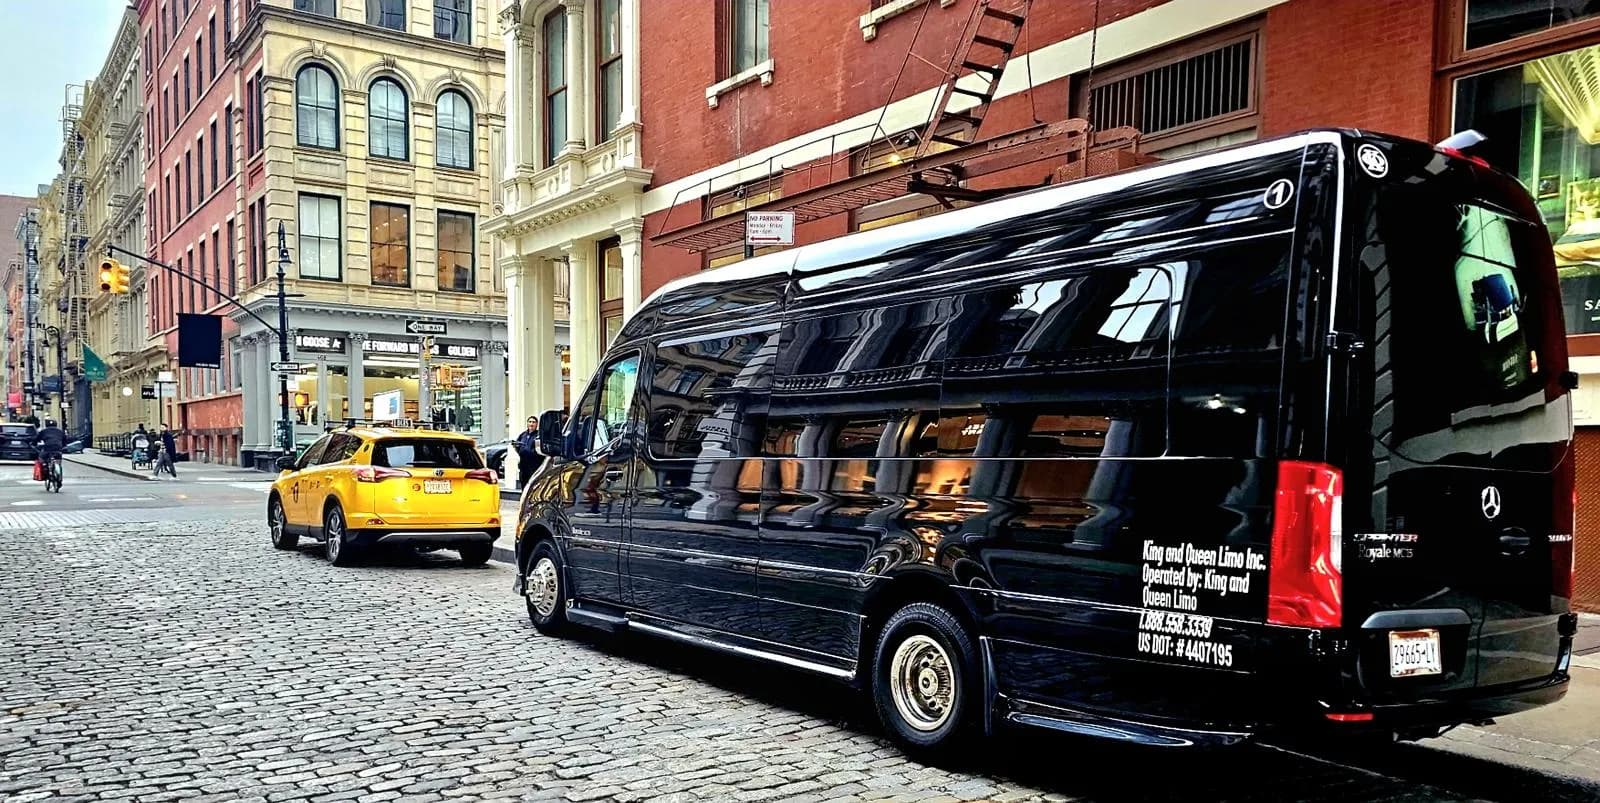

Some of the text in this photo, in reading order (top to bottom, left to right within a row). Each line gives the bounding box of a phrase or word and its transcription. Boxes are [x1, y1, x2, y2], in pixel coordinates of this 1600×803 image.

[1271, 182, 1285, 205] 1
[303, 336, 330, 348] GOOSE
[373, 340, 408, 353] FORWARD
[448, 346, 476, 357] GOLDEN
[1143, 540, 1266, 570] King and Queen Limo Inc.
[1143, 563, 1250, 596] Operated by: King and
[1143, 586, 1197, 611] Queen Limo
[1139, 610, 1213, 638] 1.888.558.3339
[1138, 632, 1150, 652] US
[1152, 634, 1174, 656] DOT:
